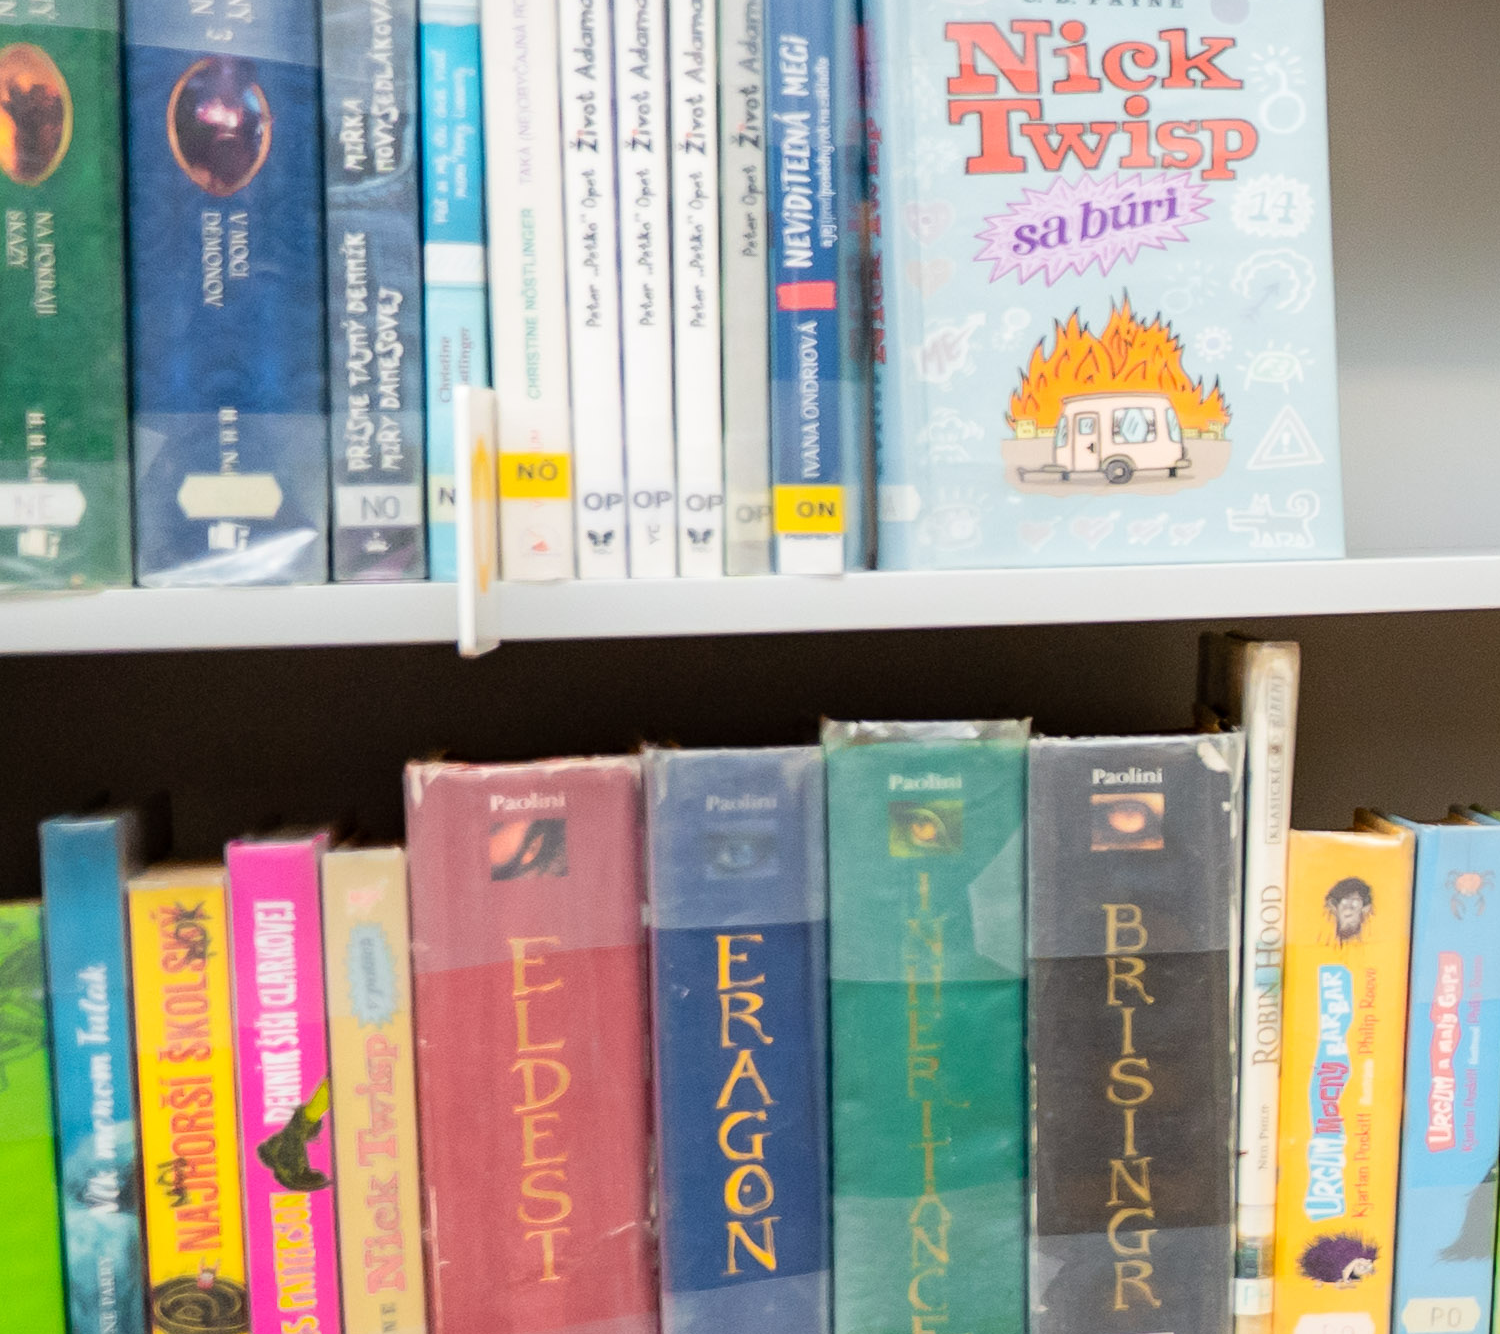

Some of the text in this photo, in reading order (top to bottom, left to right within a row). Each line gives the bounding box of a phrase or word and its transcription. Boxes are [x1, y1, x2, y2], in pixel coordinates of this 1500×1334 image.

[944, 20, 1243, 97] Nick
[948, 96, 1260, 180] Twisp
[1012, 192, 1180, 256] sa búri
[801, 322, 819, 476] IVANA ONDRIOVÁ
[797, 501, 836, 519] ON
[490, 793, 566, 811] Paolini
[888, 774, 963, 791] Paolini
[1091, 768, 1163, 786] Paolini
[1252, 884, 1283, 1065] ROBIN HOOD
[507, 936, 571, 1281] ELDEST
[717, 934, 776, 1273] ERAGON
[1102, 903, 1162, 1311] BRISINGR
